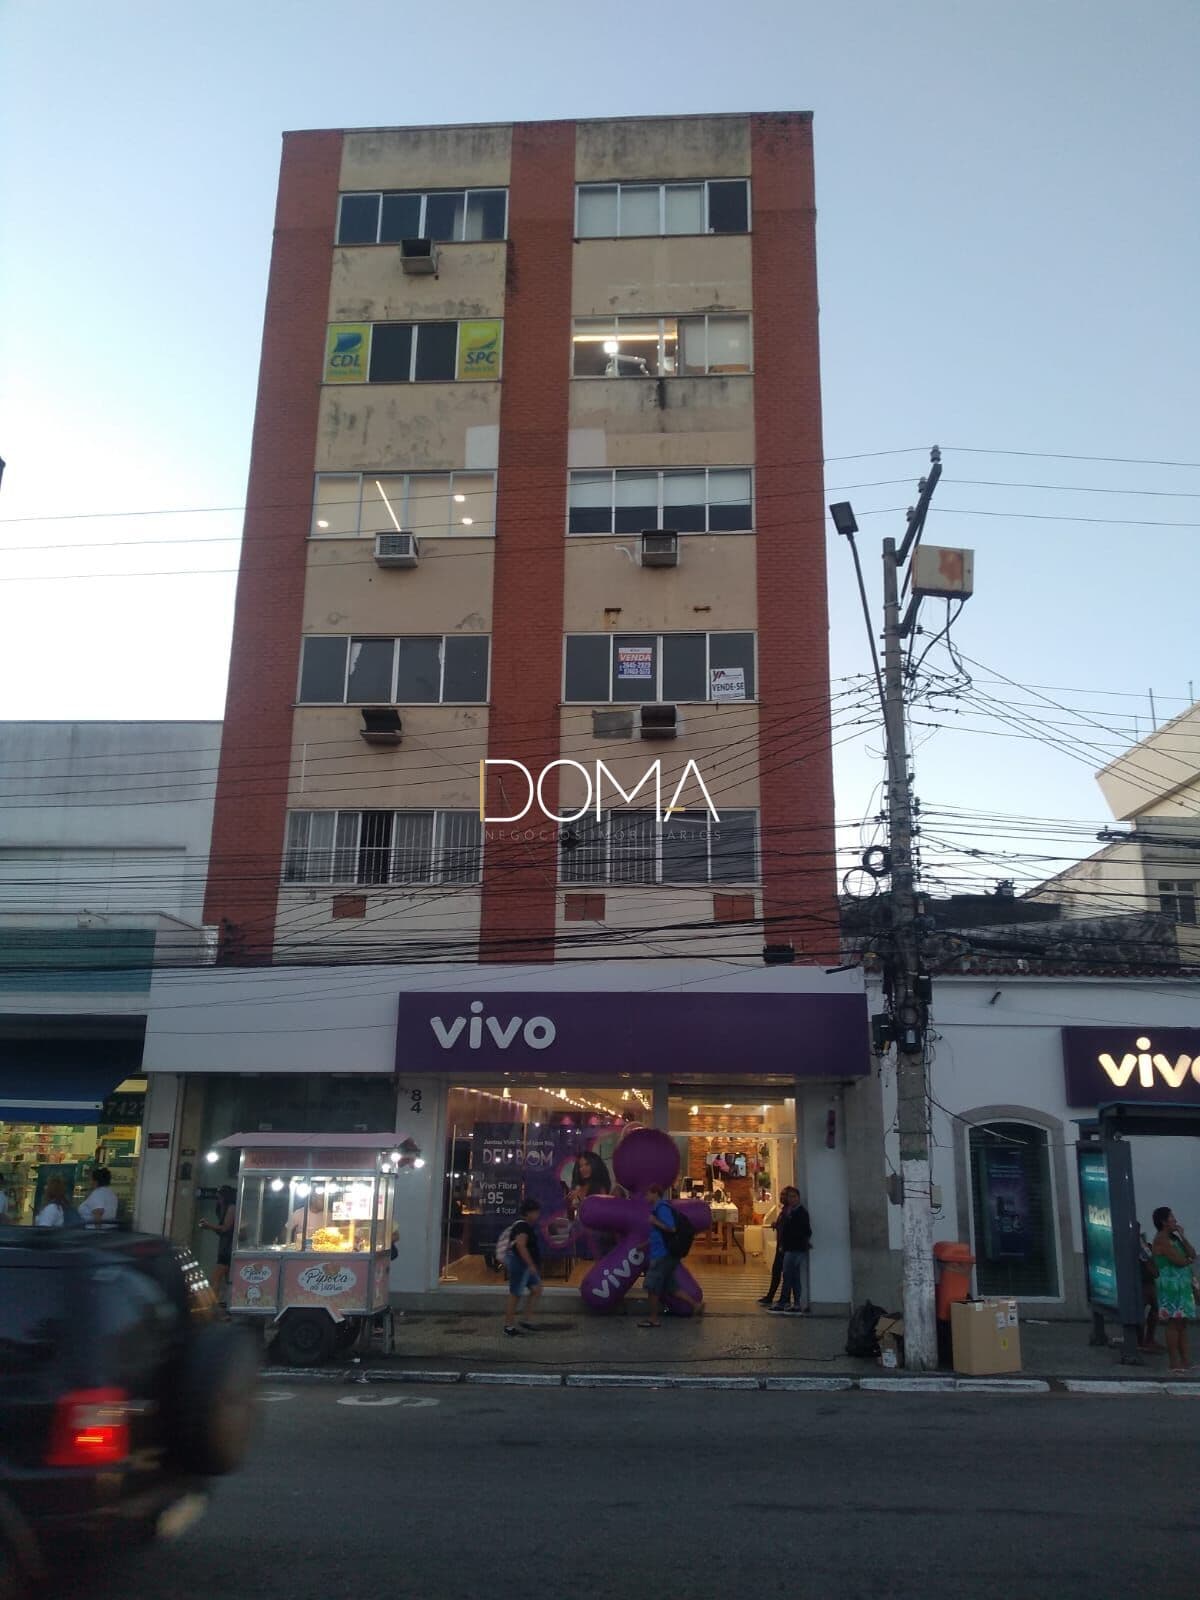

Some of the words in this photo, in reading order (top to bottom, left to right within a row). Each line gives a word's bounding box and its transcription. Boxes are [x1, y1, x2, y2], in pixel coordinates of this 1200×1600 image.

[330, 353, 361, 368] CDL
[464, 350, 497, 366] SPC
[619, 653, 651, 662] VENDA
[711, 682, 744, 692] VENDE-SE
[430, 1001, 556, 1050] vivo
[487, 1191, 504, 1205] 95
[592, 1248, 645, 1298] vivo
